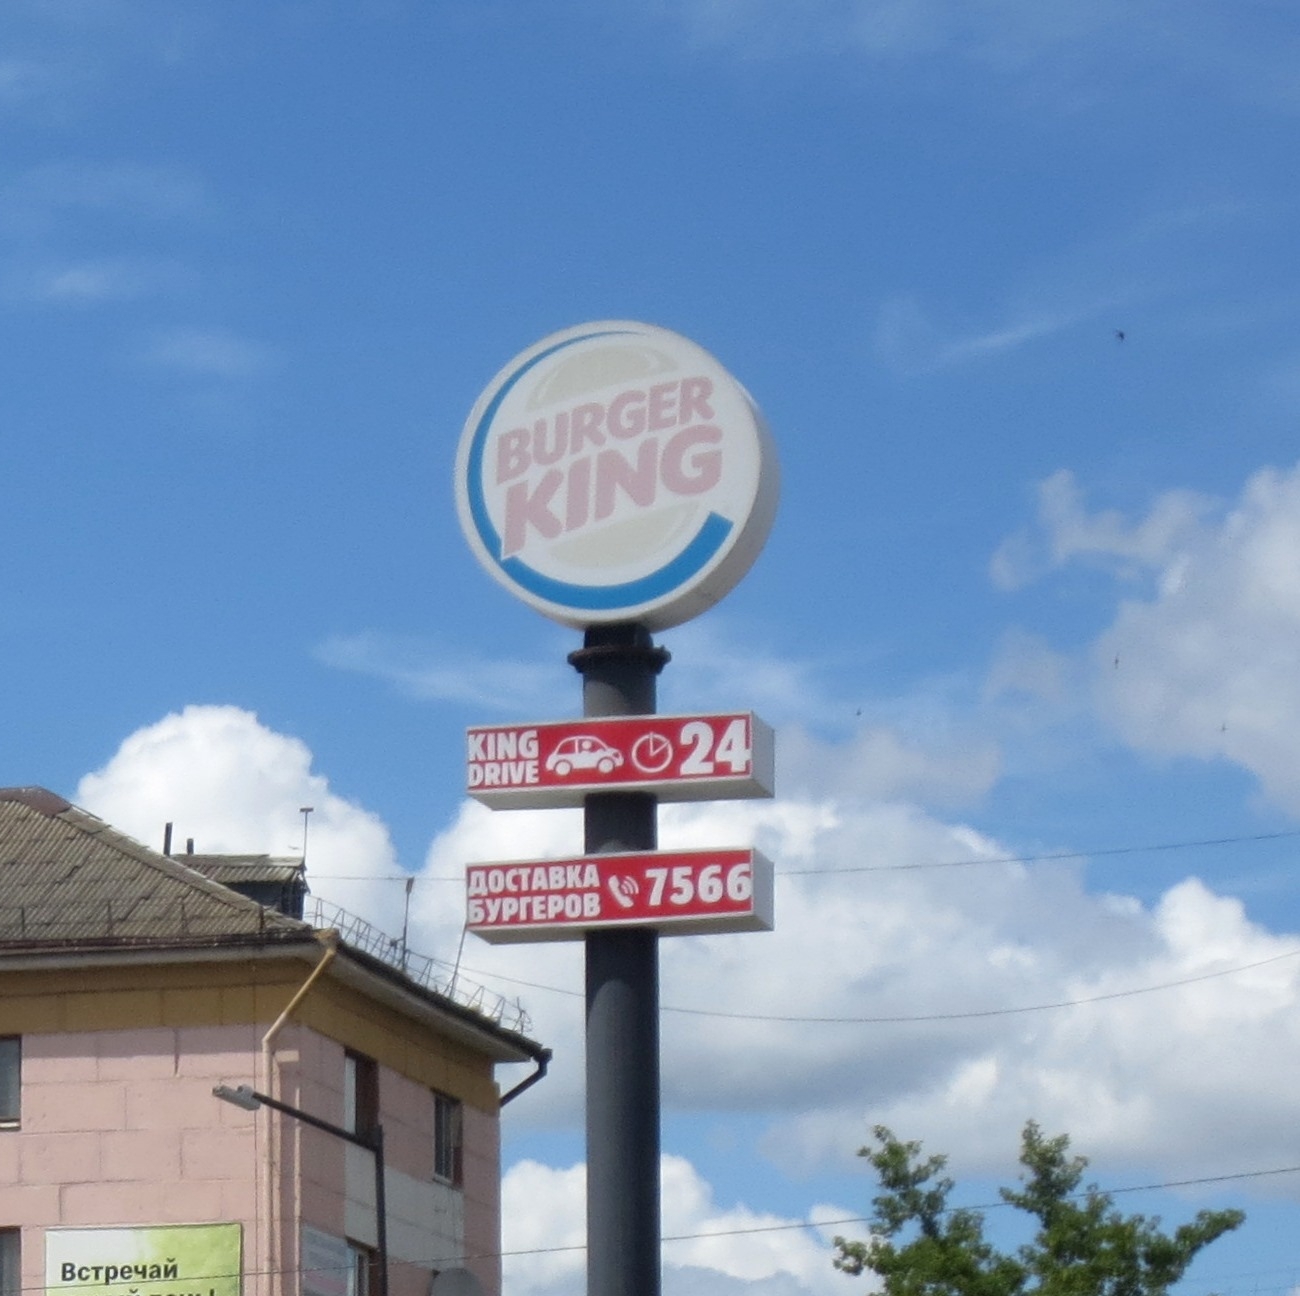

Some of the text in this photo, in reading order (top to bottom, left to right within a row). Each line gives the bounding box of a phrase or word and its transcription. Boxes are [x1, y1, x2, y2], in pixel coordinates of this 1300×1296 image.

[497, 377, 715, 486] BURGER
[504, 424, 723, 557] KING
[468, 719, 751, 776] KING 24
[468, 761, 539, 787] DRIVE
[468, 863, 751, 906] ДОСТАВКА 7566
[468, 893, 600, 924] БУРГЕРОВ
[61, 1258, 178, 1285] Встречай
